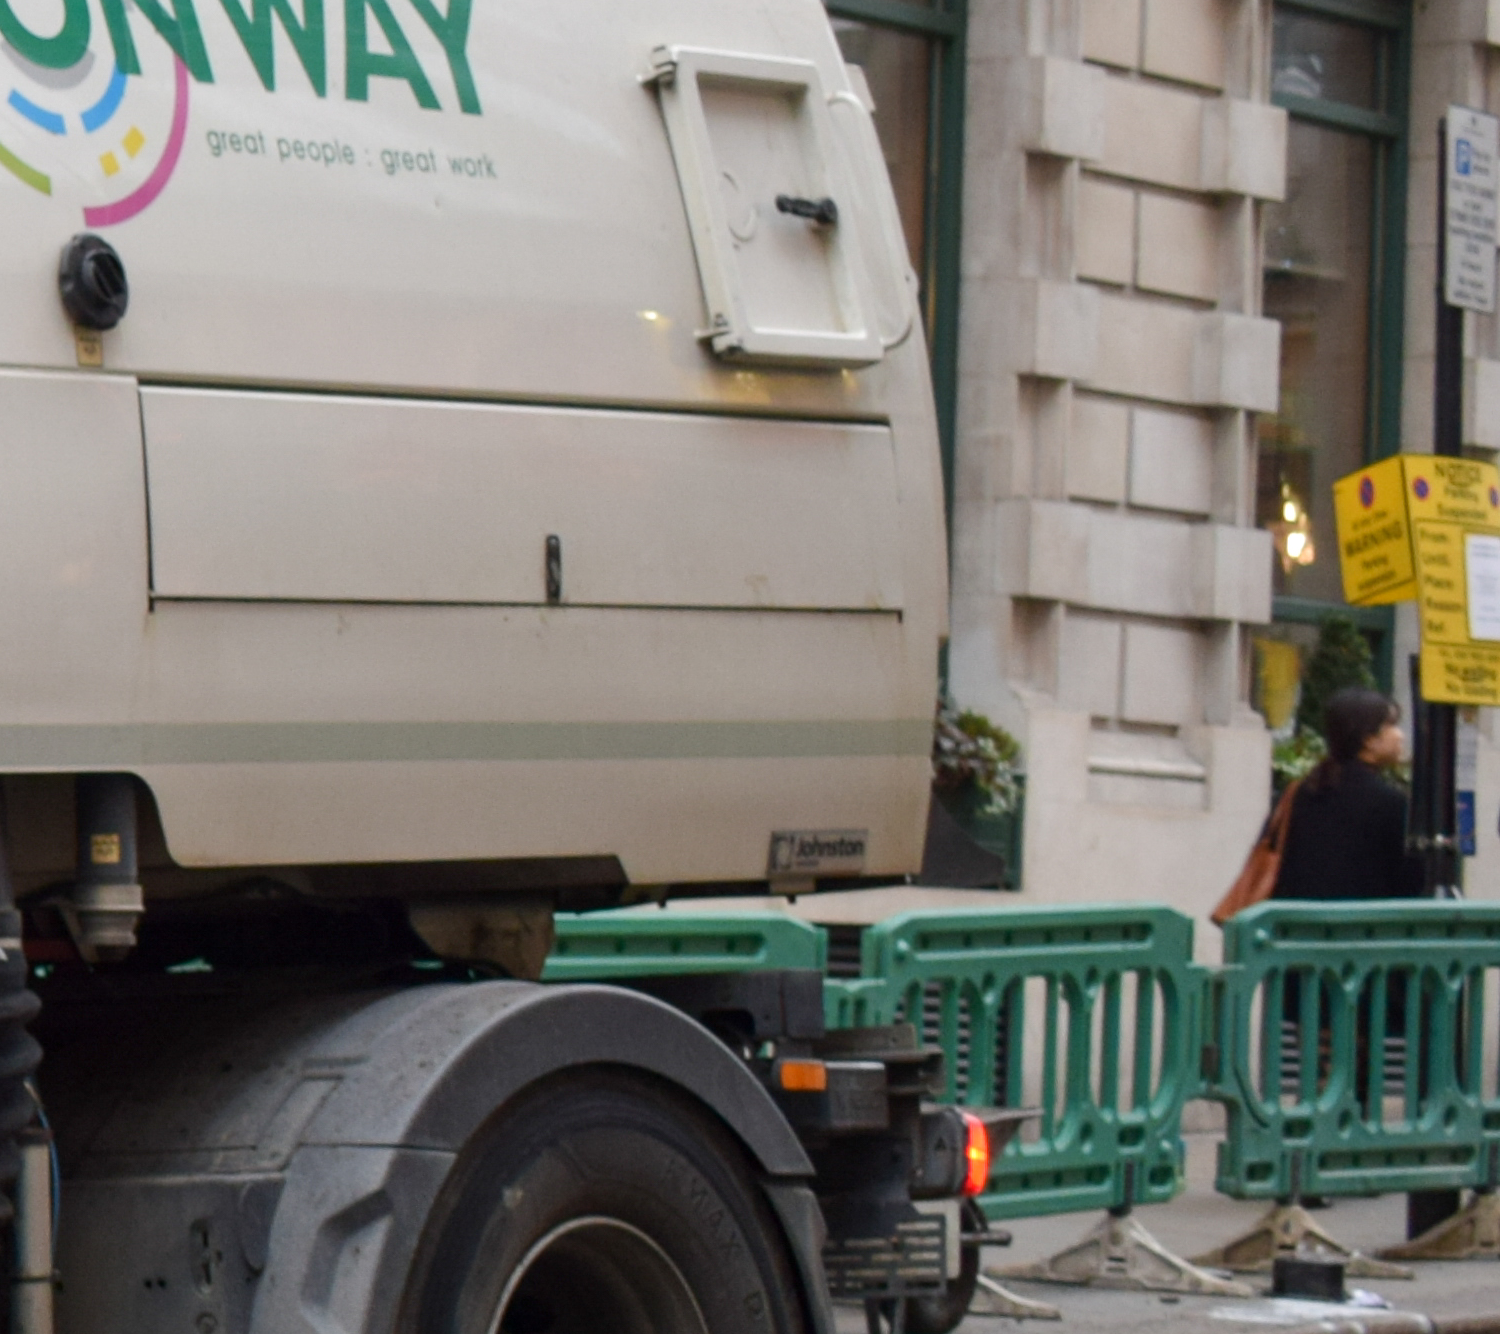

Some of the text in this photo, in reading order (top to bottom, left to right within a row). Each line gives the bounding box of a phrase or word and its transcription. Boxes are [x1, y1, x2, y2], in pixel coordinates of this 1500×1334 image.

[206, 129, 266, 158] great
[277, 136, 355, 168] people
[381, 148, 438, 176] great
[448, 154, 497, 179] work
